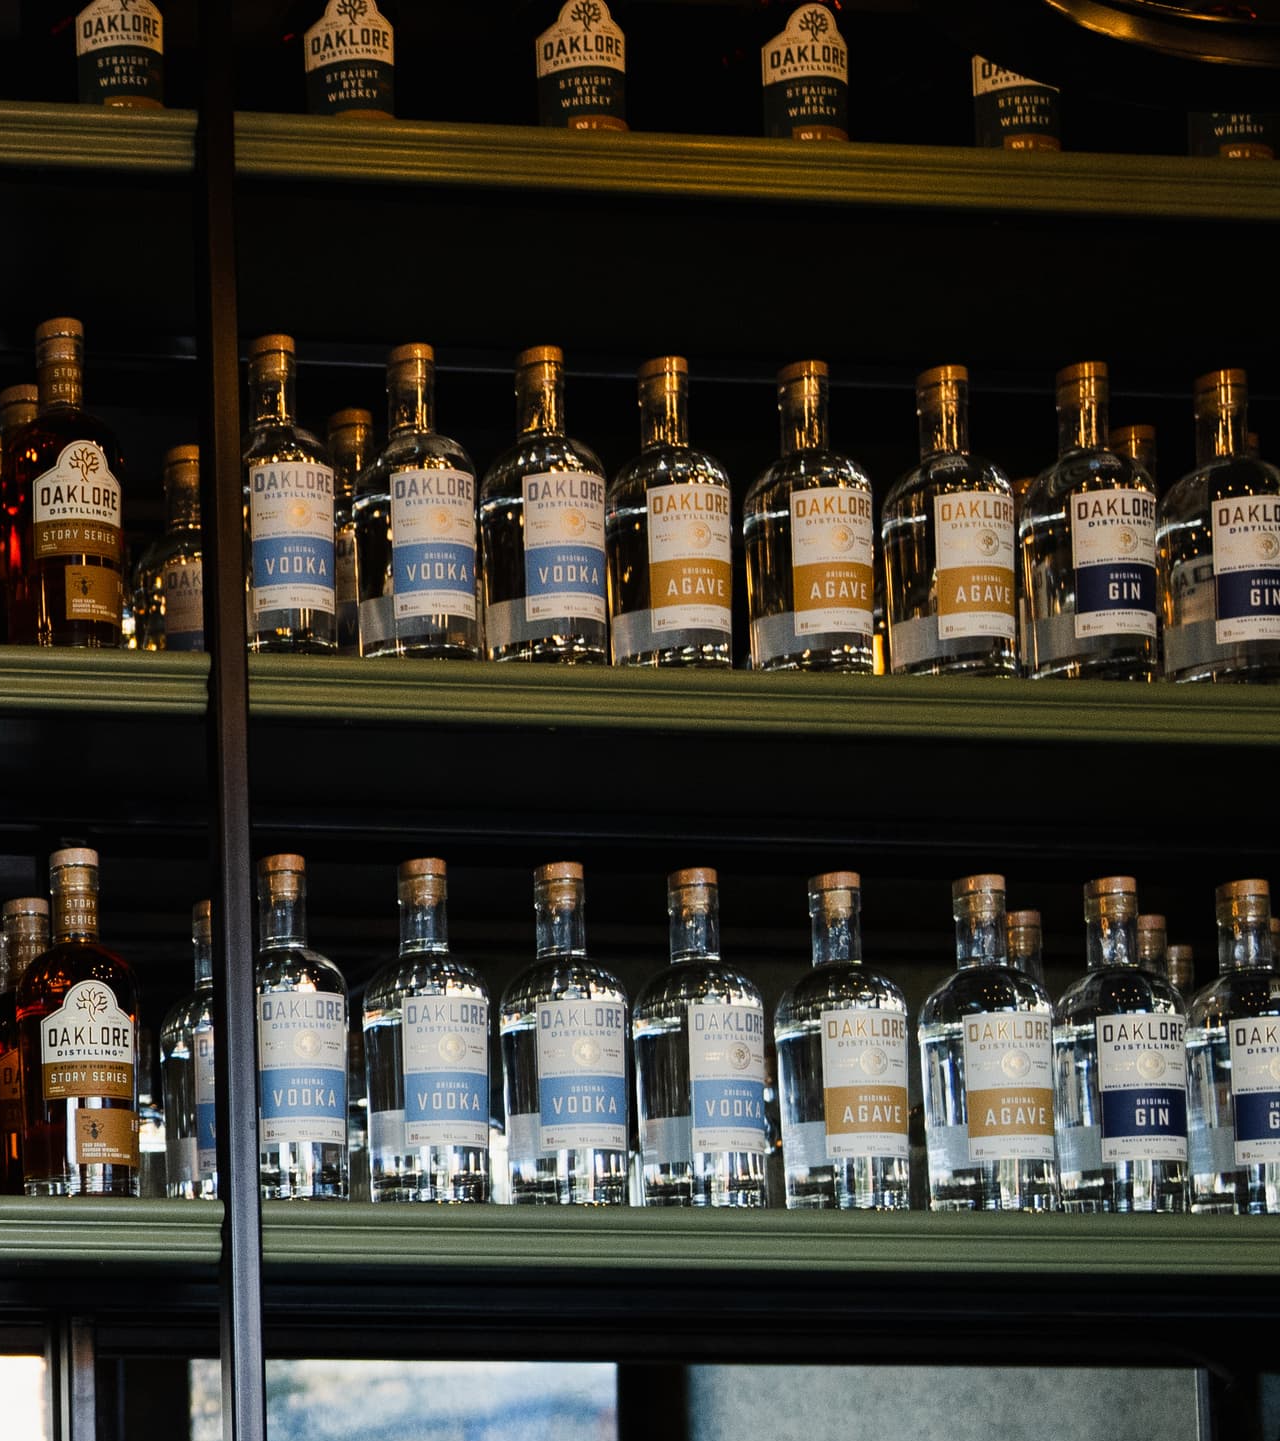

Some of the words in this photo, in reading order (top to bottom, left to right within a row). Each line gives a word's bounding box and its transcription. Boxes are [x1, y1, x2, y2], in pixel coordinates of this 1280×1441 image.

[83, 15, 159, 39] OAKLORE
[311, 28, 389, 56] OAKLORE
[543, 35, 622, 61] OAKLORE
[98, 57, 149, 68] STRAIGHT
[771, 45, 846, 70] OAKLORE
[114, 67, 134, 76] RYE
[326, 70, 378, 83] STRAIGHT
[99, 77, 148, 88] WHISKEY
[343, 79, 363, 88] RYE
[559, 77, 612, 90] STRAIGHT
[576, 87, 597, 96] RYE
[328, 90, 378, 102] WHISKEY
[562, 96, 610, 108] WHISKEY
[786, 87, 838, 99] STRAIGHT
[805, 95, 825, 105] RYE
[789, 106, 837, 117] WHISKEY
[254, 470, 331, 495] OAKLORE
[395, 478, 471, 500] OAKLORE
[527, 480, 602, 504] OAKLORE
[41, 486, 117, 511] OAKLORE
[653, 492, 728, 516] OAKLORE
[796, 496, 871, 519] OAKLORE
[941, 502, 1014, 523] OAKLORE
[1078, 499, 1154, 521] OAKLORE
[43, 529, 78, 542] STORY
[85, 529, 116, 545] SERIES
[265, 556, 328, 577] VODKA
[406, 563, 467, 583] VODKA
[539, 565, 599, 585] VODKA
[667, 578, 724, 597] AGAVE
[811, 581, 867, 600] AGAVE
[956, 585, 1010, 604] AGAVE
[1109, 582, 1141, 600] GIN
[67, 899, 96, 908] STORY
[65, 915, 96, 925] SERIES
[263, 1000, 341, 1022] OAKLORE
[407, 1004, 485, 1025] OAKLORE
[541, 1009, 621, 1029] OAKLORE
[694, 1012, 764, 1032] OAKLORE
[828, 1018, 904, 1039] OAKLORE
[969, 1019, 1048, 1041] OAKLORE
[49, 1027, 129, 1048] OAKLORE
[1103, 1023, 1182, 1042] OAKLORE
[51, 1072, 86, 1083] STORY
[93, 1072, 127, 1083] SERIES
[273, 1088, 336, 1107] VODKA
[417, 1092, 479, 1110] VODKA
[553, 1096, 616, 1114] VODKA
[705, 1099, 761, 1118] VODKA
[843, 1105, 901, 1123] AGAVE
[985, 1107, 1046, 1125] AGAVE
[1135, 1108, 1169, 1126] GIN
